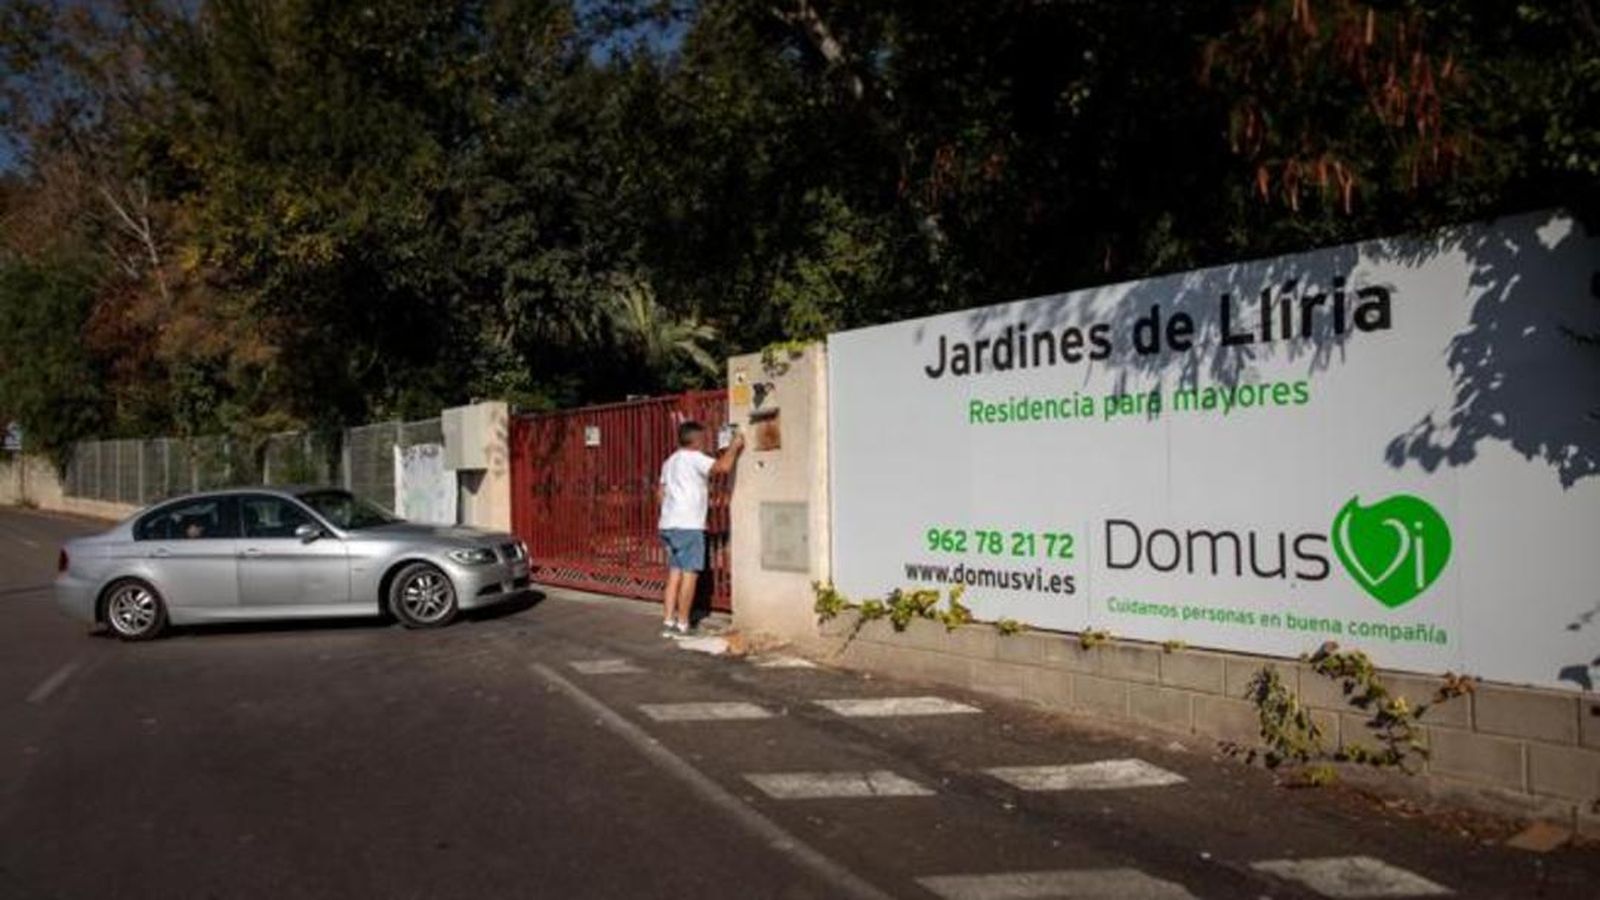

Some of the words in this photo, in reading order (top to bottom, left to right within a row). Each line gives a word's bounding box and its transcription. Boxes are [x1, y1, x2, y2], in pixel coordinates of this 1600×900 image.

[925, 322, 1112, 379] Jardines
[1133, 304, 1194, 356] de
[1220, 276, 1392, 347] Llíria
[969, 391, 1095, 424] Residencia
[1104, 390, 1162, 421] para
[1173, 380, 1309, 416] mayores
[927, 528, 967, 552] 962
[975, 530, 1003, 555] 78
[1011, 532, 1035, 557] 21
[1042, 533, 1074, 558] 72
[905, 563, 1076, 595] www.domusvi.es
[1106, 596, 1178, 618] Cuidamos
[1181, 606, 1254, 626] personas
[1259, 613, 1282, 628] en
[1286, 614, 1342, 635] buena
[1348, 622, 1448, 645] compañía
